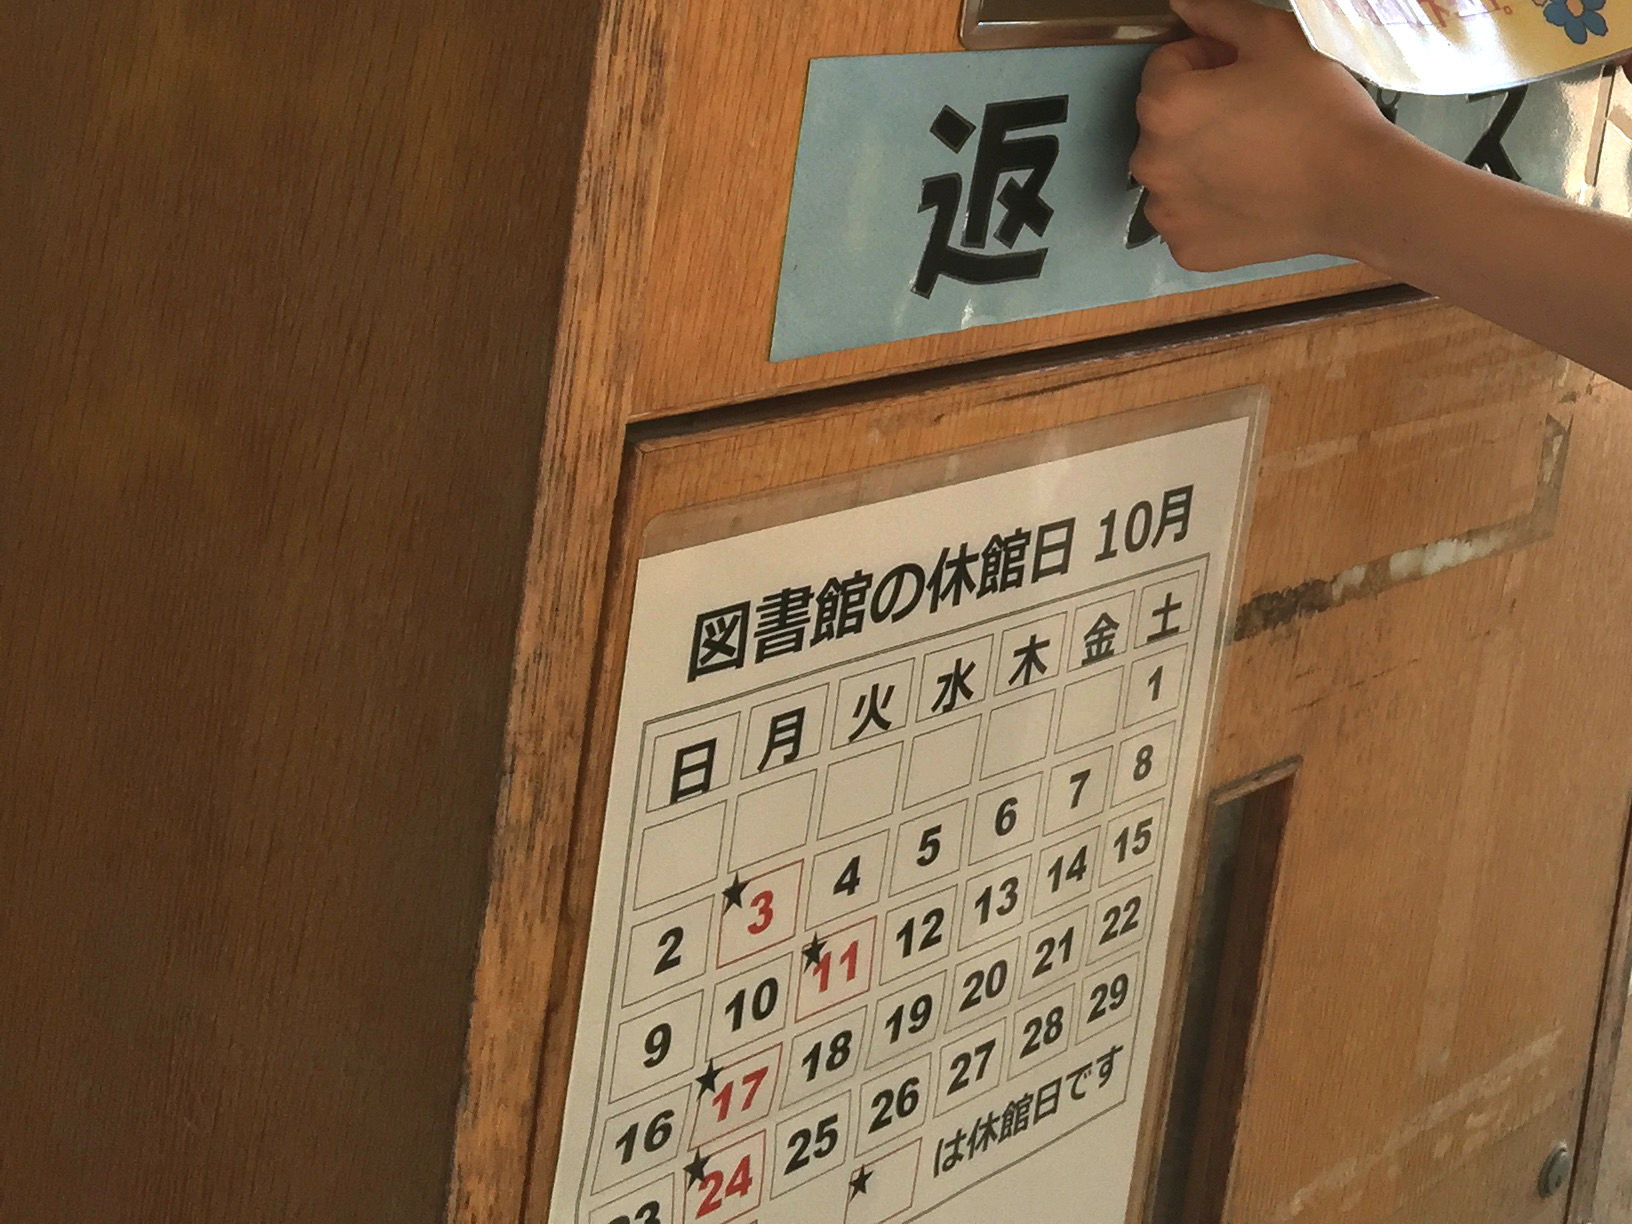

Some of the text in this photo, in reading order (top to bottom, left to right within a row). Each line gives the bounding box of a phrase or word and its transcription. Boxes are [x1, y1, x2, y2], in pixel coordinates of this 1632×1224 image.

[687, 484, 1194, 684] 図書館の休館日 10月
[1147, 665, 1164, 702] 1
[670, 591, 1183, 805] 日 月 火 水 木 金 土
[642, 816, 1154, 1069] 9 10 11 12 13 14 15
[653, 744, 1154, 976] 2 3 4 5 6 7 8
[606, 972, 1130, 1224] 3 24 25 26 27 28 29
[615, 895, 1142, 1165] 16 17 18 19 20 21 22
[932, 1044, 1125, 1179] は休館日です
